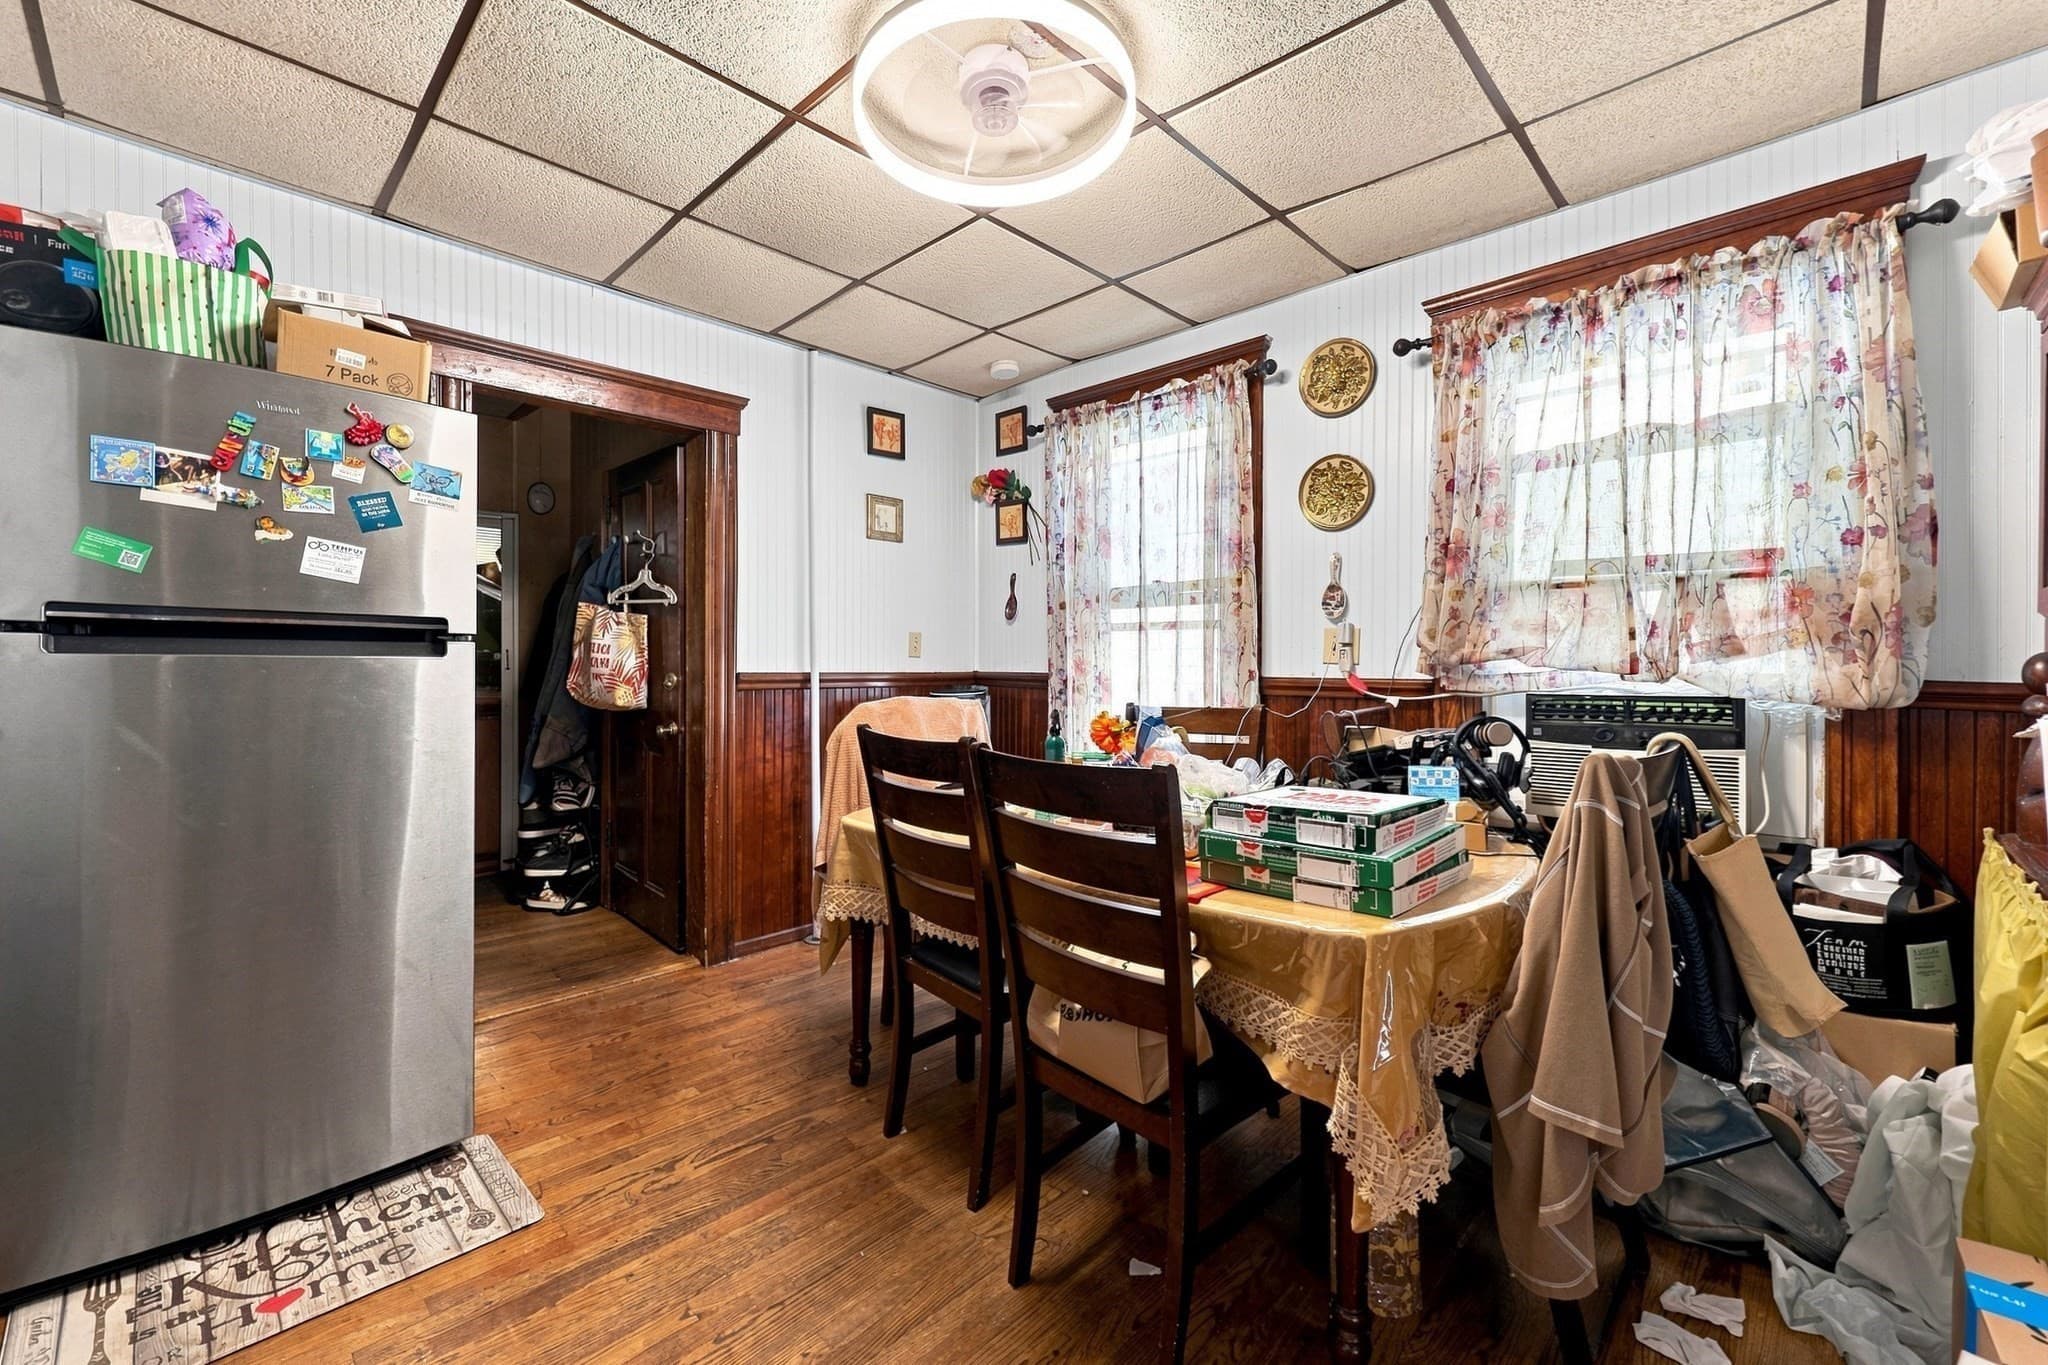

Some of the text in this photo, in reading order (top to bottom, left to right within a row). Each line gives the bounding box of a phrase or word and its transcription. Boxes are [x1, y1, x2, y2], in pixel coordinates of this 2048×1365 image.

[325, 364, 380, 387] 7 Pack
[401, 1218, 425, 1234] of
[429, 1204, 464, 1222] the
[162, 1186, 458, 1311] Kitchen
